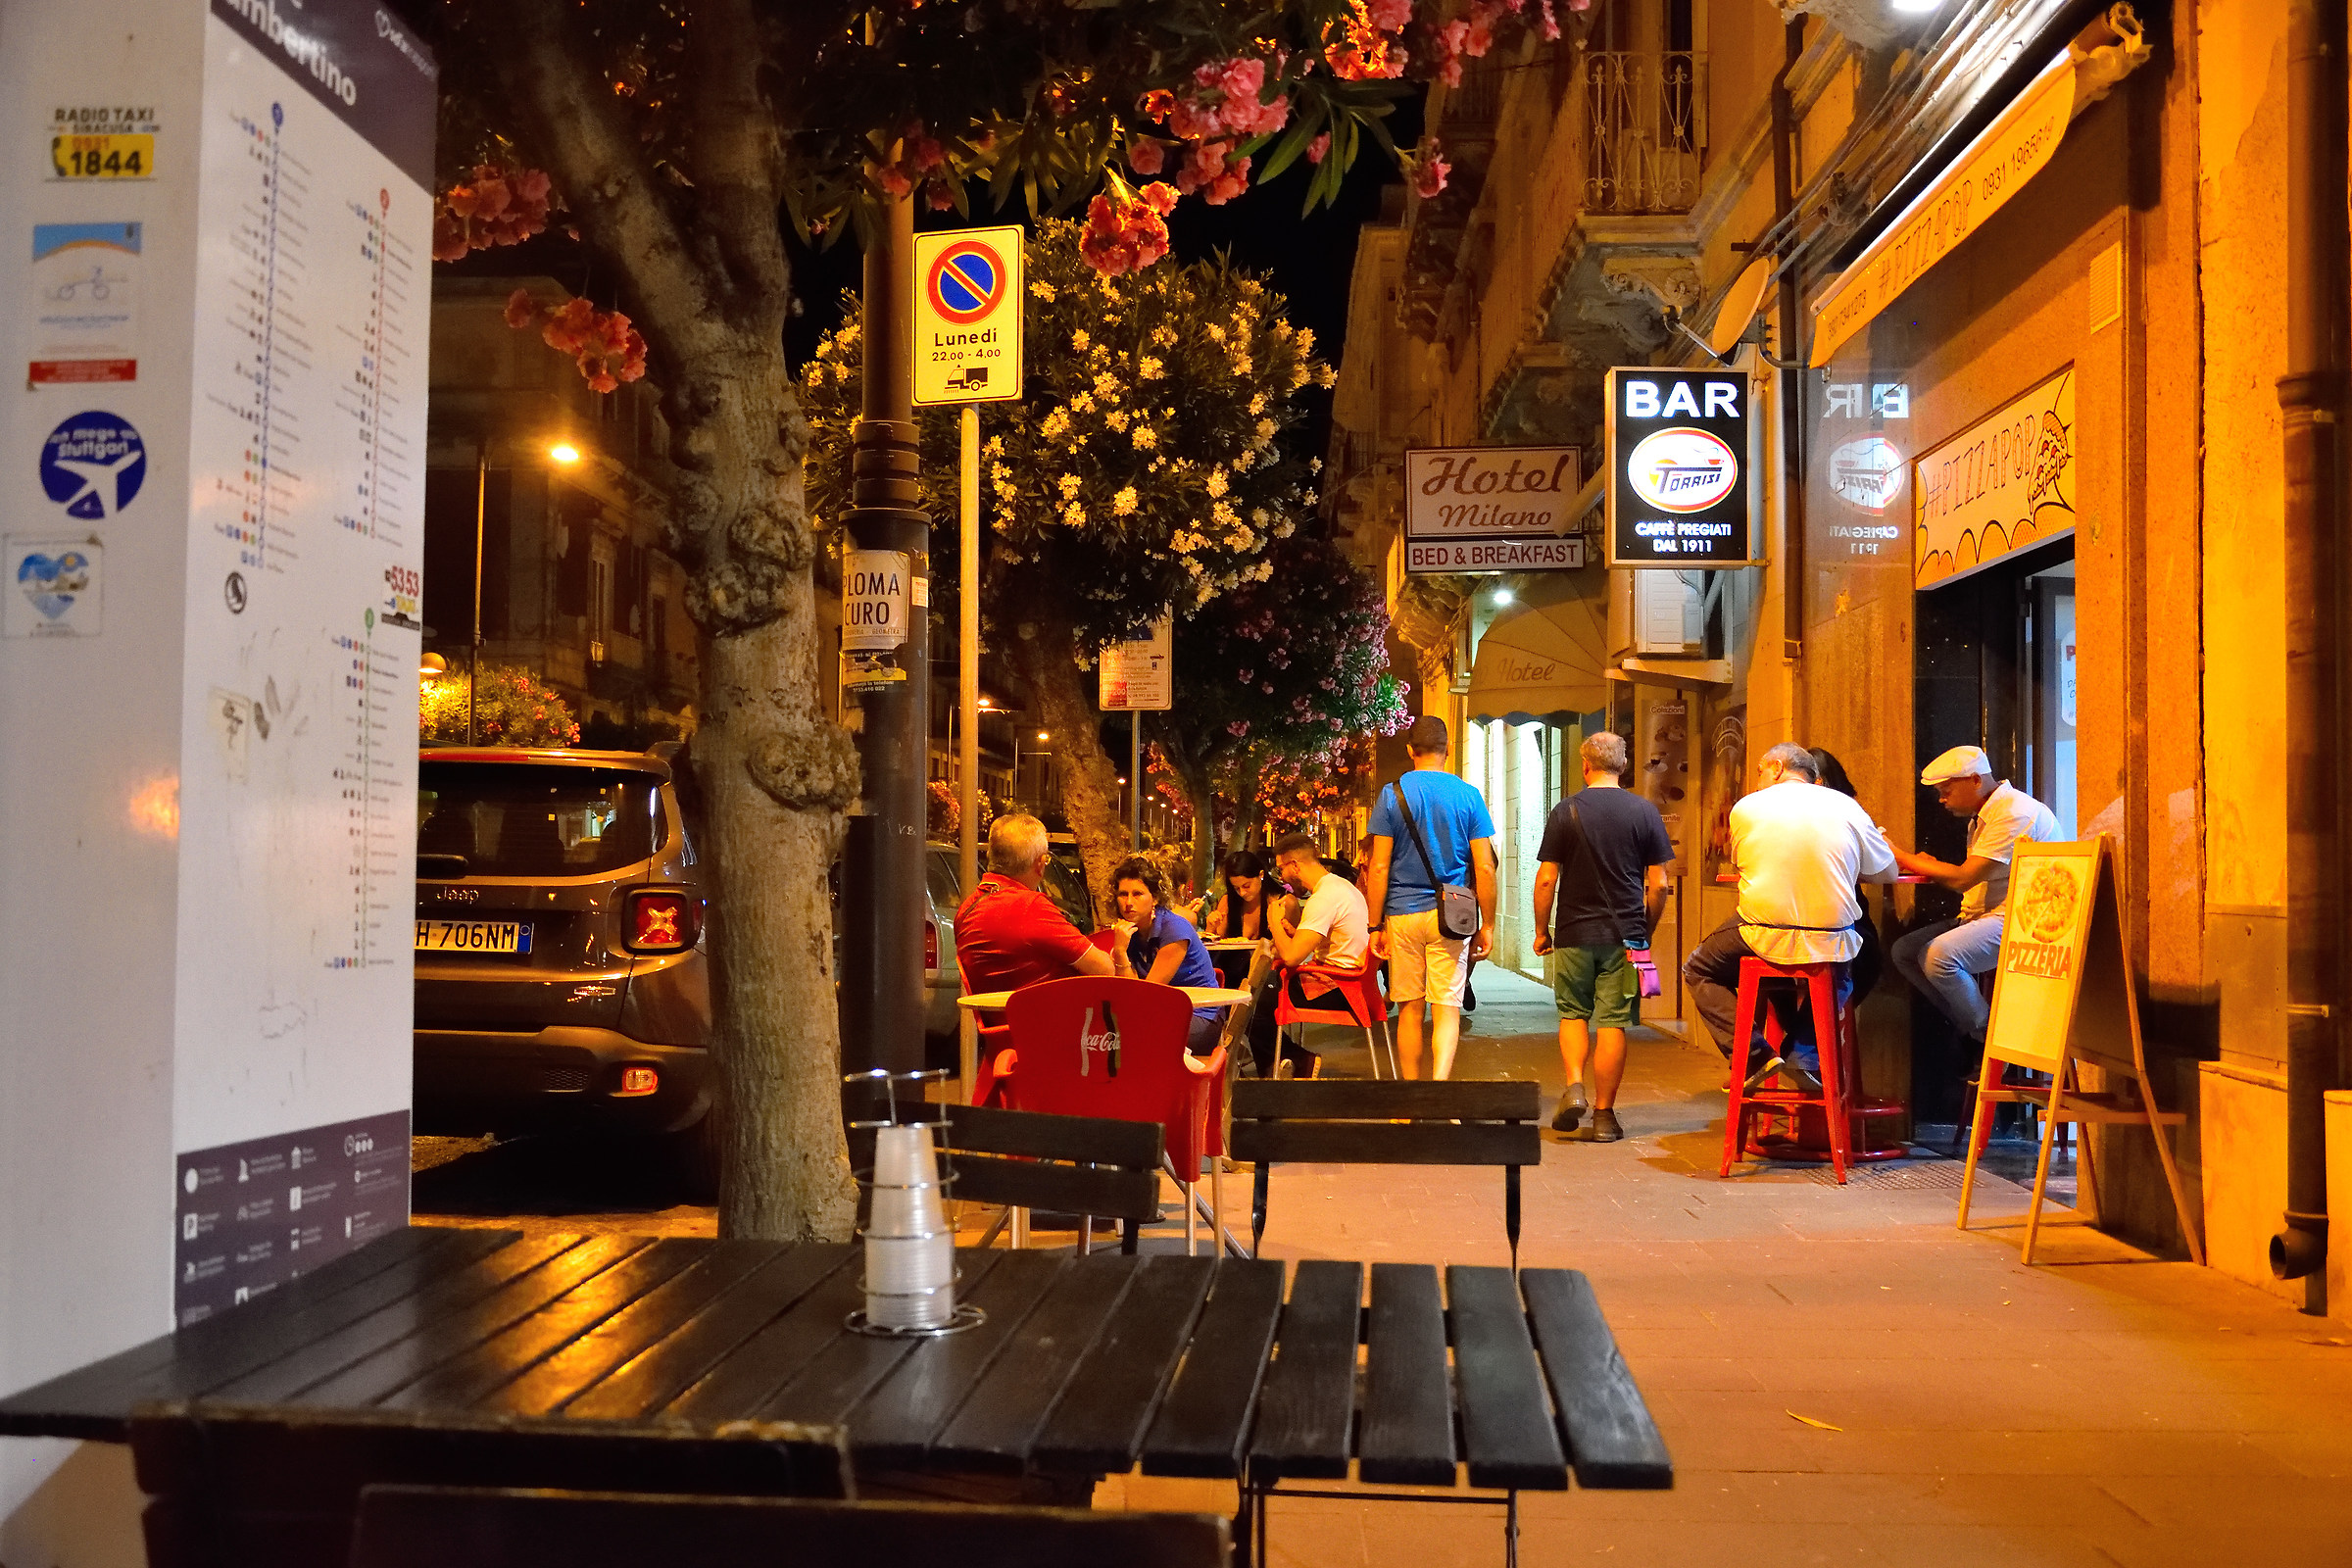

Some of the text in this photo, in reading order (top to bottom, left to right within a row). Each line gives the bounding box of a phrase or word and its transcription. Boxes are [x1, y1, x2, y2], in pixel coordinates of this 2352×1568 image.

[55, 108, 155, 122] RADIO TAXI
[70, 150, 142, 175] 1844
[1983, 162, 2006, 201] 0931
[1878, 179, 1973, 300] #PIZZAPOP
[935, 327, 998, 347] Lunedi
[932, 351, 964, 362] 22.00
[975, 349, 1002, 359] 4.00
[1625, 380, 1740, 417] BAR
[1421, 454, 1570, 496] Hotel
[1929, 414, 2036, 518] #PIZZAPOP
[1655, 466, 1723, 494] TORRISI
[1438, 504, 1551, 528] Milano
[1635, 519, 1732, 537] CAFFÈ PREGIATI
[1412, 544, 1578, 566] BED & BREAKFAST
[1652, 539, 1712, 553] DAL 1911
[1498, 658, 1556, 683] Hotel
[435, 886, 480, 906] Jeep
[439, 923, 516, 950] 706NM
[2007, 941, 2072, 979] PIZZERIA
